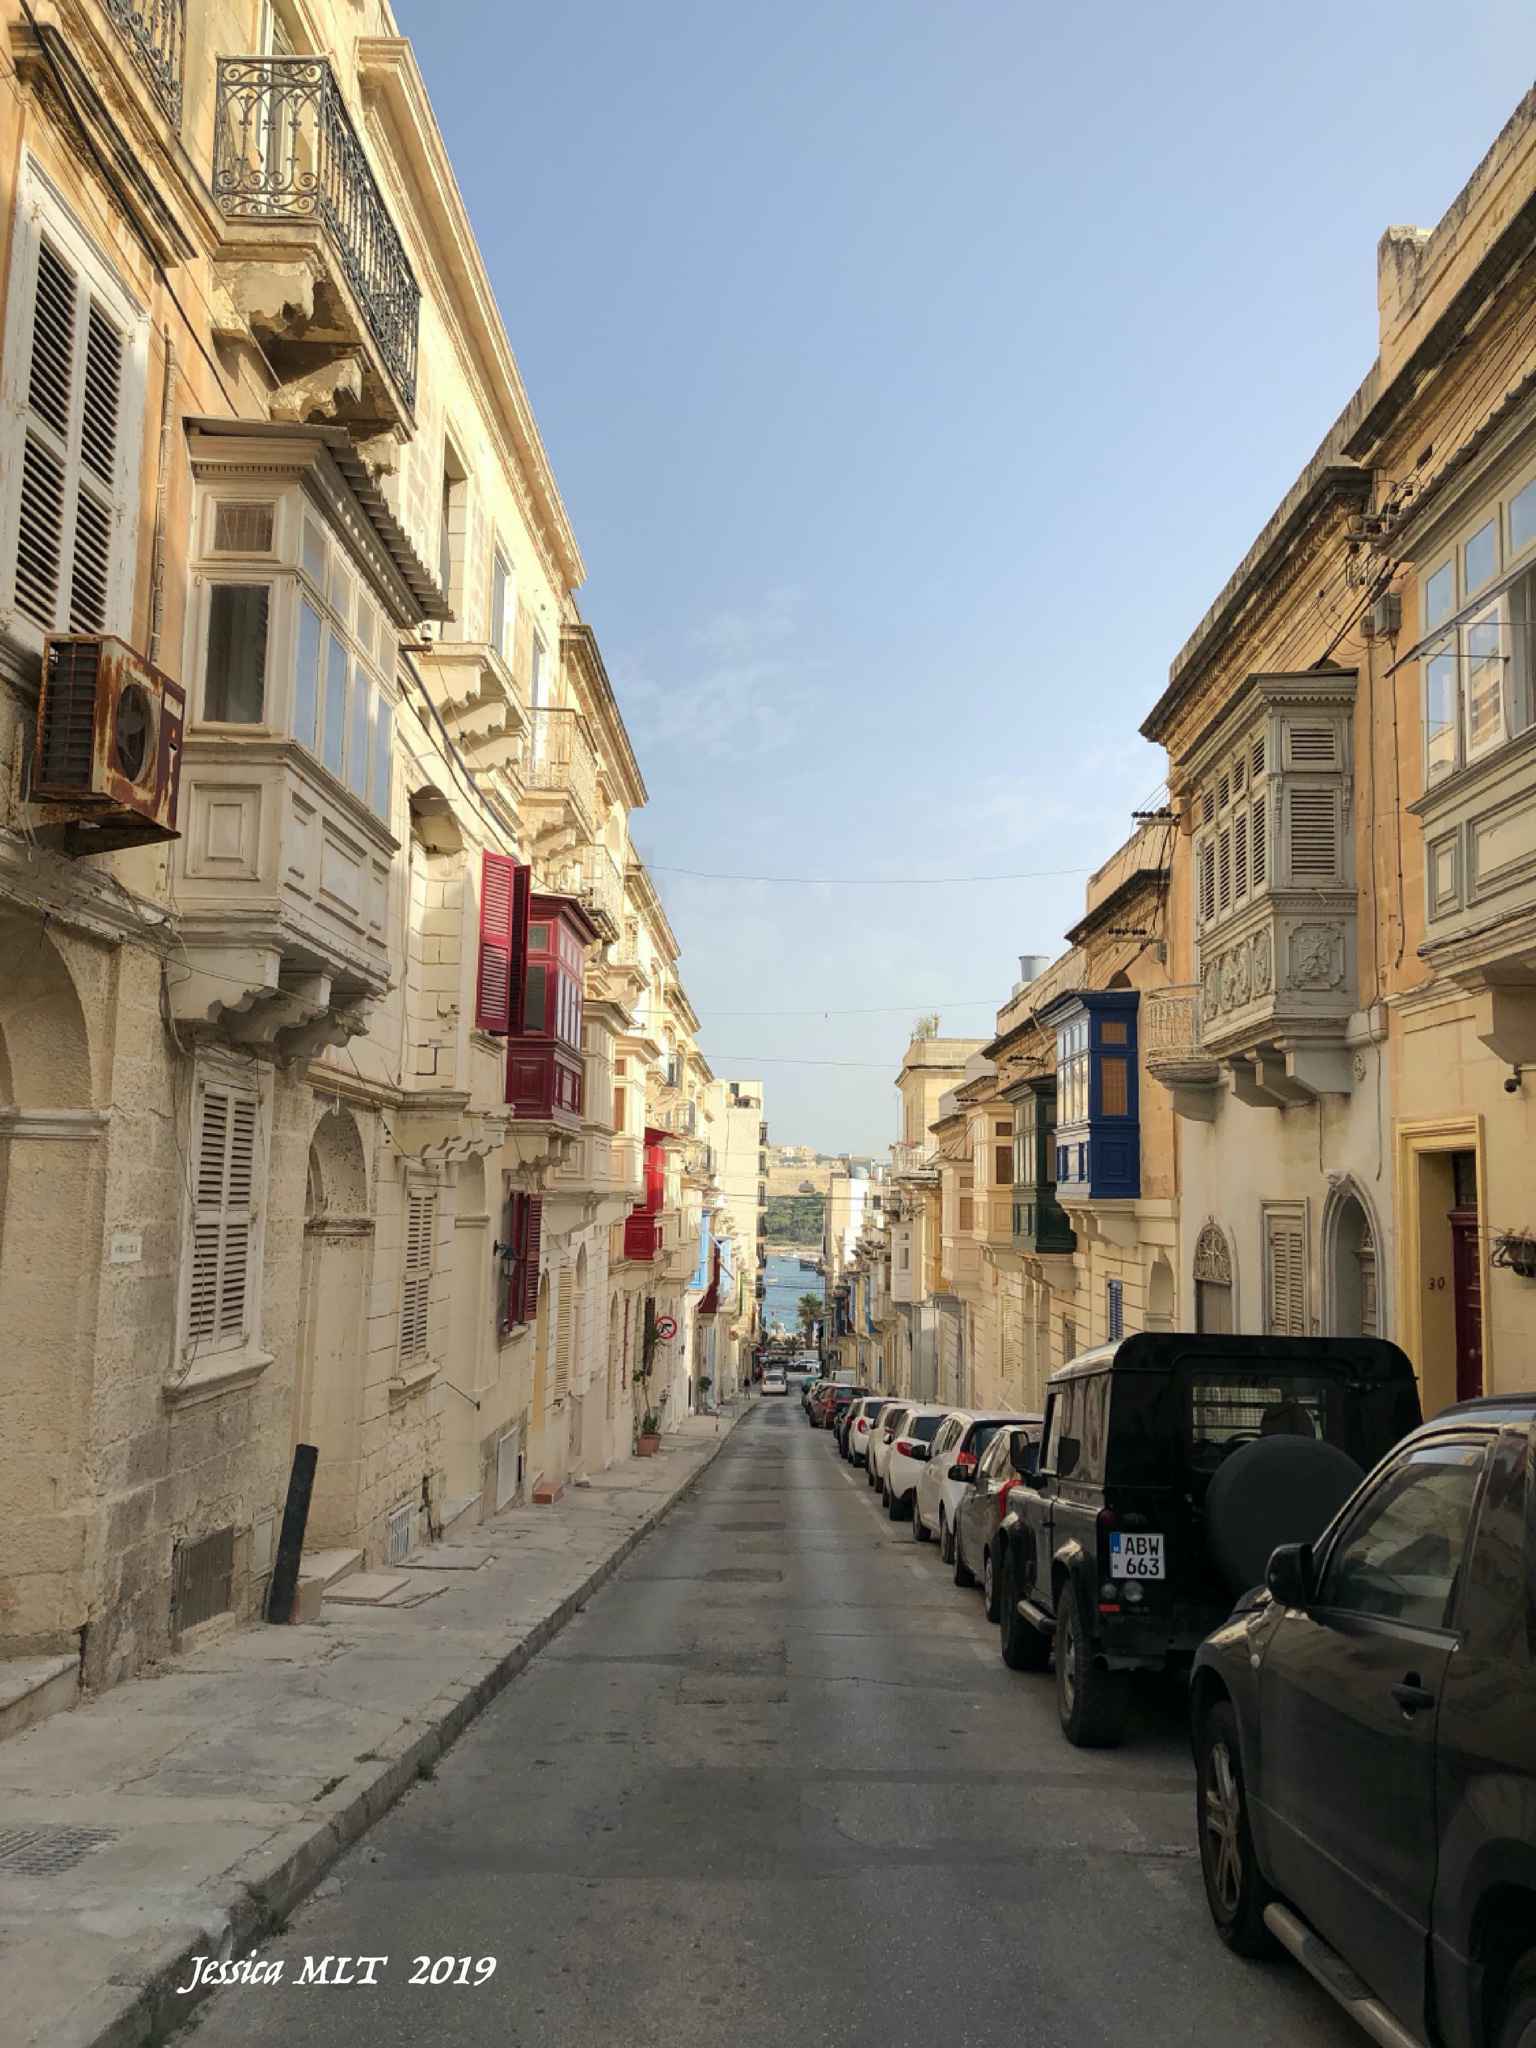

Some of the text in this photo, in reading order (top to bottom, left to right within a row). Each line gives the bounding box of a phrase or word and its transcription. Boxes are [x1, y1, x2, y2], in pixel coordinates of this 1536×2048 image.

[1427, 1276, 1445, 1291] 30
[1125, 1537, 1160, 1555] ABW
[1126, 1558, 1160, 1576] 663
